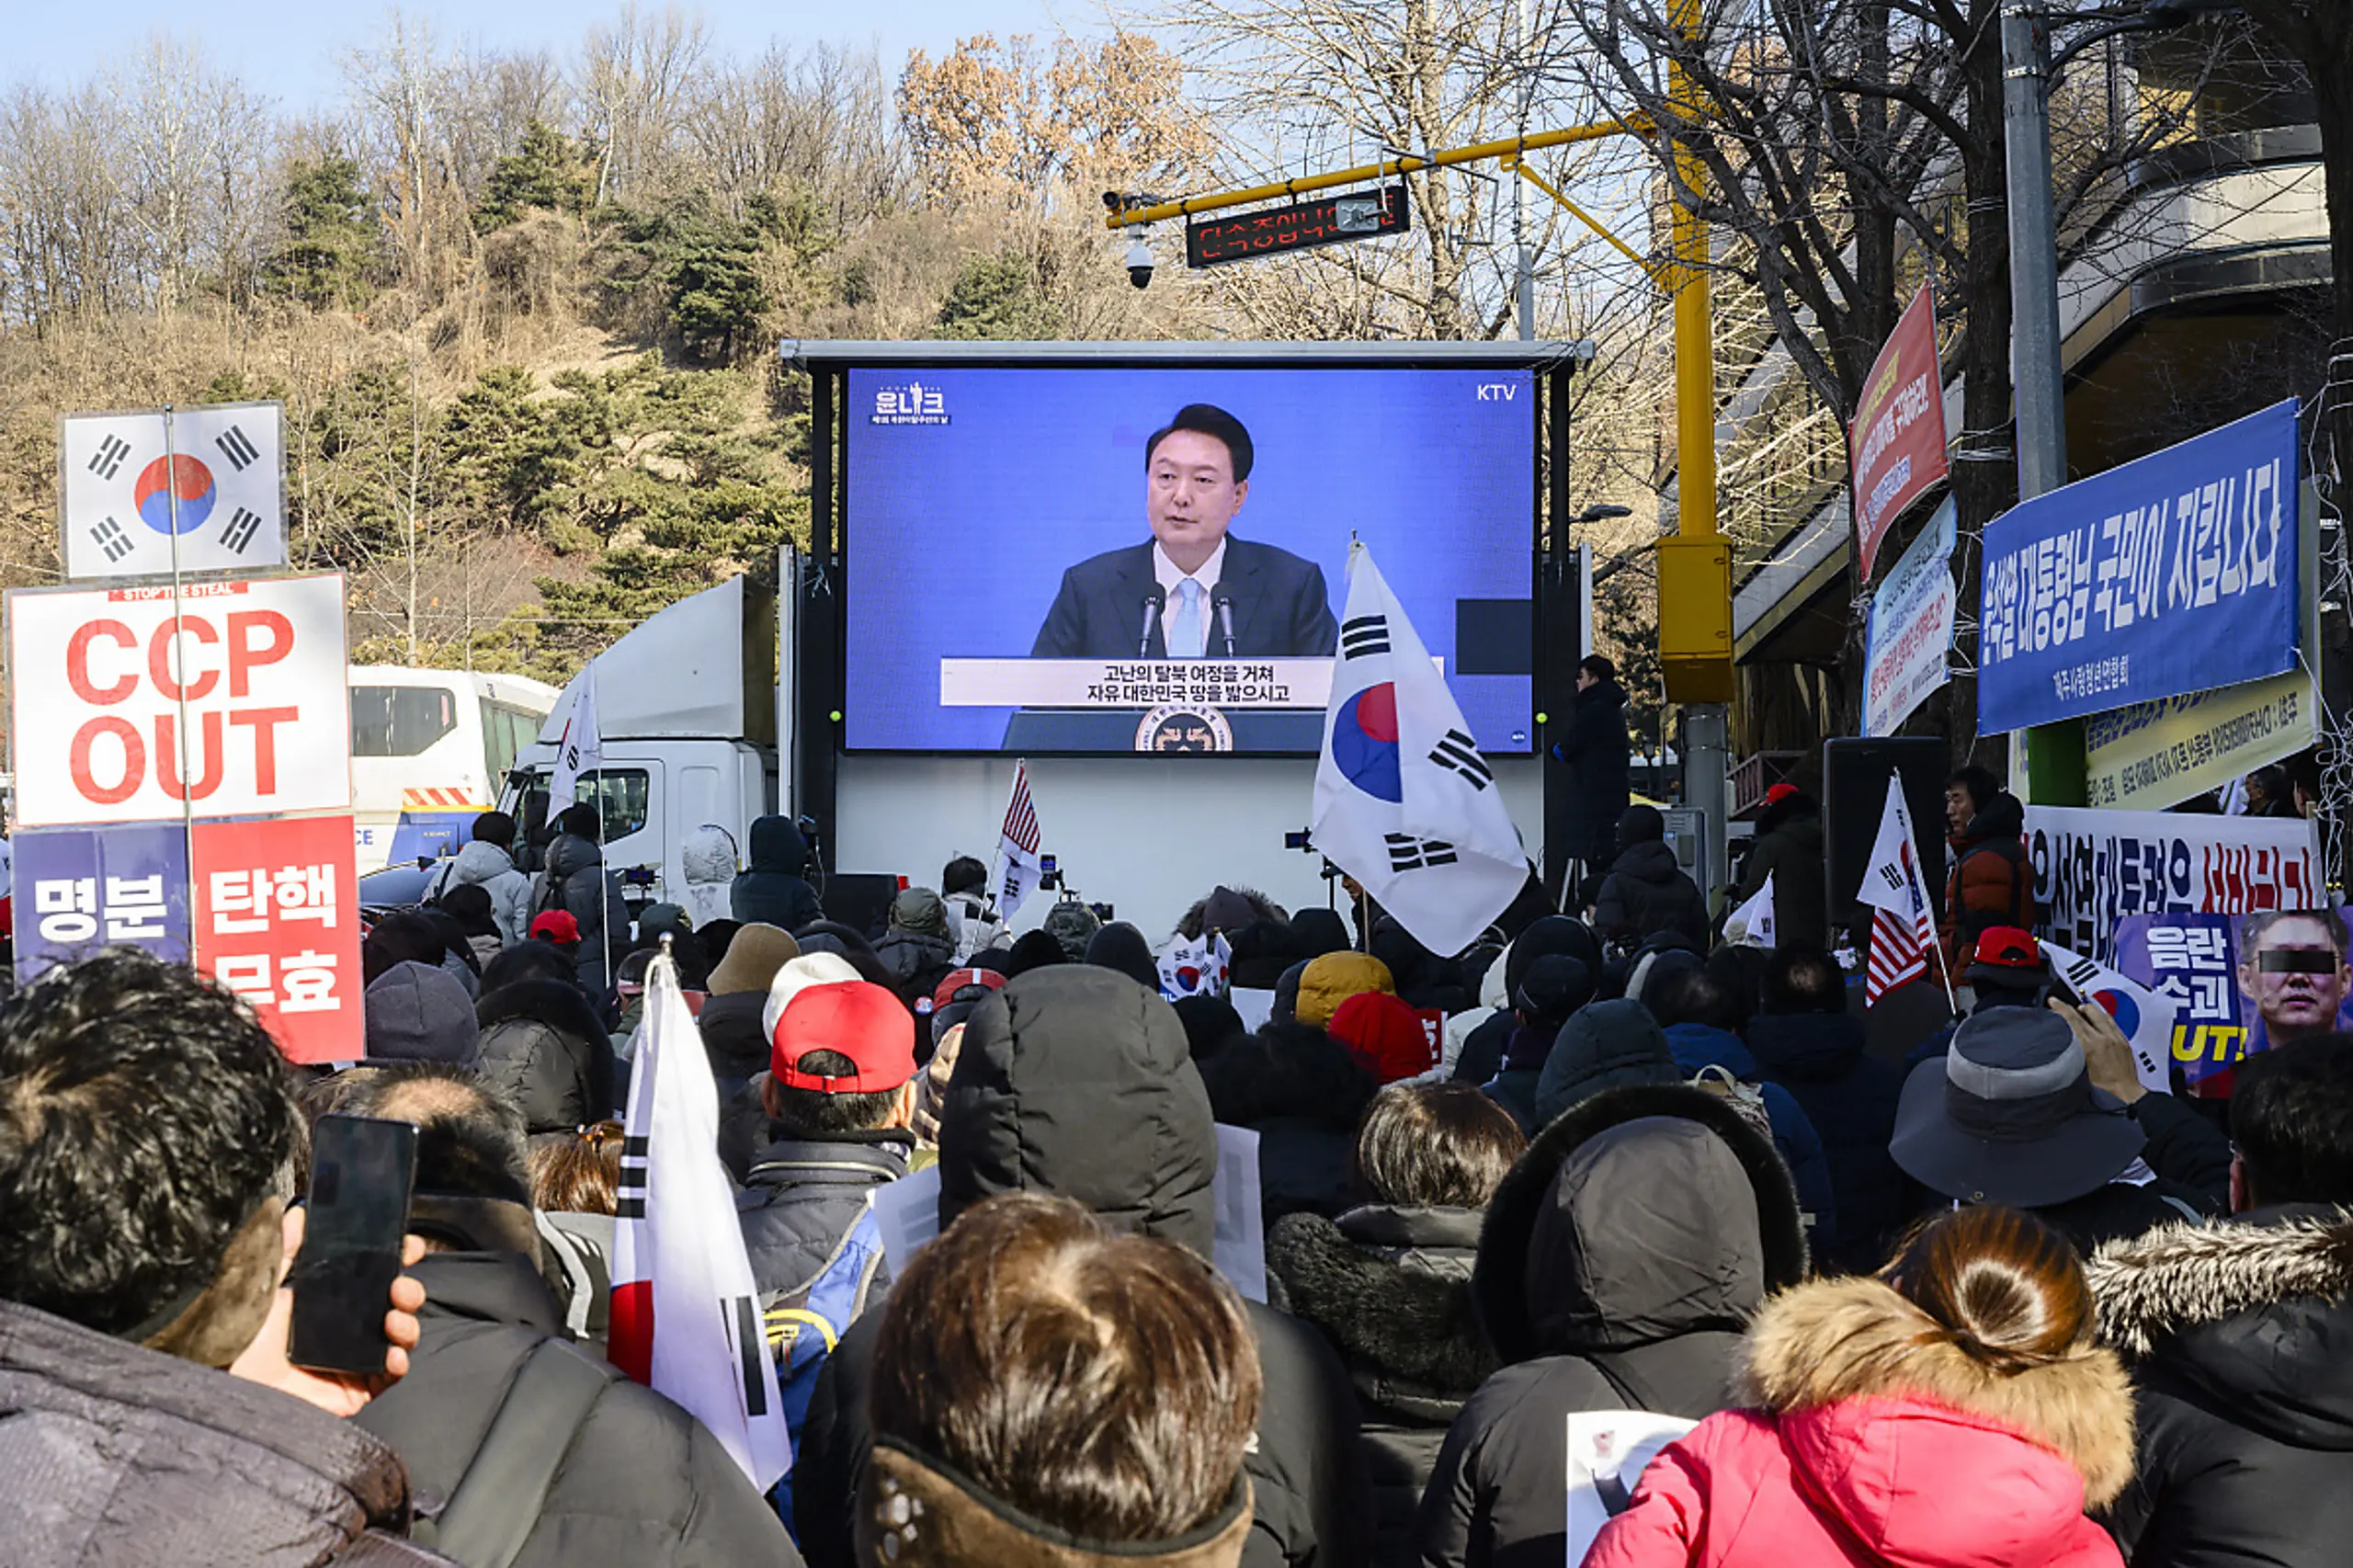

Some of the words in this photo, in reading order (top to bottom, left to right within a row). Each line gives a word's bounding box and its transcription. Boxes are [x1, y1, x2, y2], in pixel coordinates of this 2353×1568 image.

[1477, 383, 1517, 401] KTV
[2018, 523, 2096, 653] 대통령님
[2094, 498, 2169, 632] 국민이
[2166, 457, 2281, 610] 지킵니다
[190, 583, 234, 597] STEAL
[66, 609, 295, 707] CCP
[1104, 665, 1151, 683] 고난의
[1155, 665, 1187, 683] 탈북
[1190, 665, 1238, 683] 여정을
[1243, 665, 1274, 683] 거쳐
[1087, 685, 1120, 702] 자유
[1123, 685, 1187, 702] 대한민국
[1190, 685, 1222, 702] 땅을
[1226, 685, 1290, 702] 밟으시고
[69, 706, 300, 805] OUT
[35, 875, 167, 942] 명분
[210, 864, 336, 935] 탄핵
[2147, 926, 2227, 971] 음란
